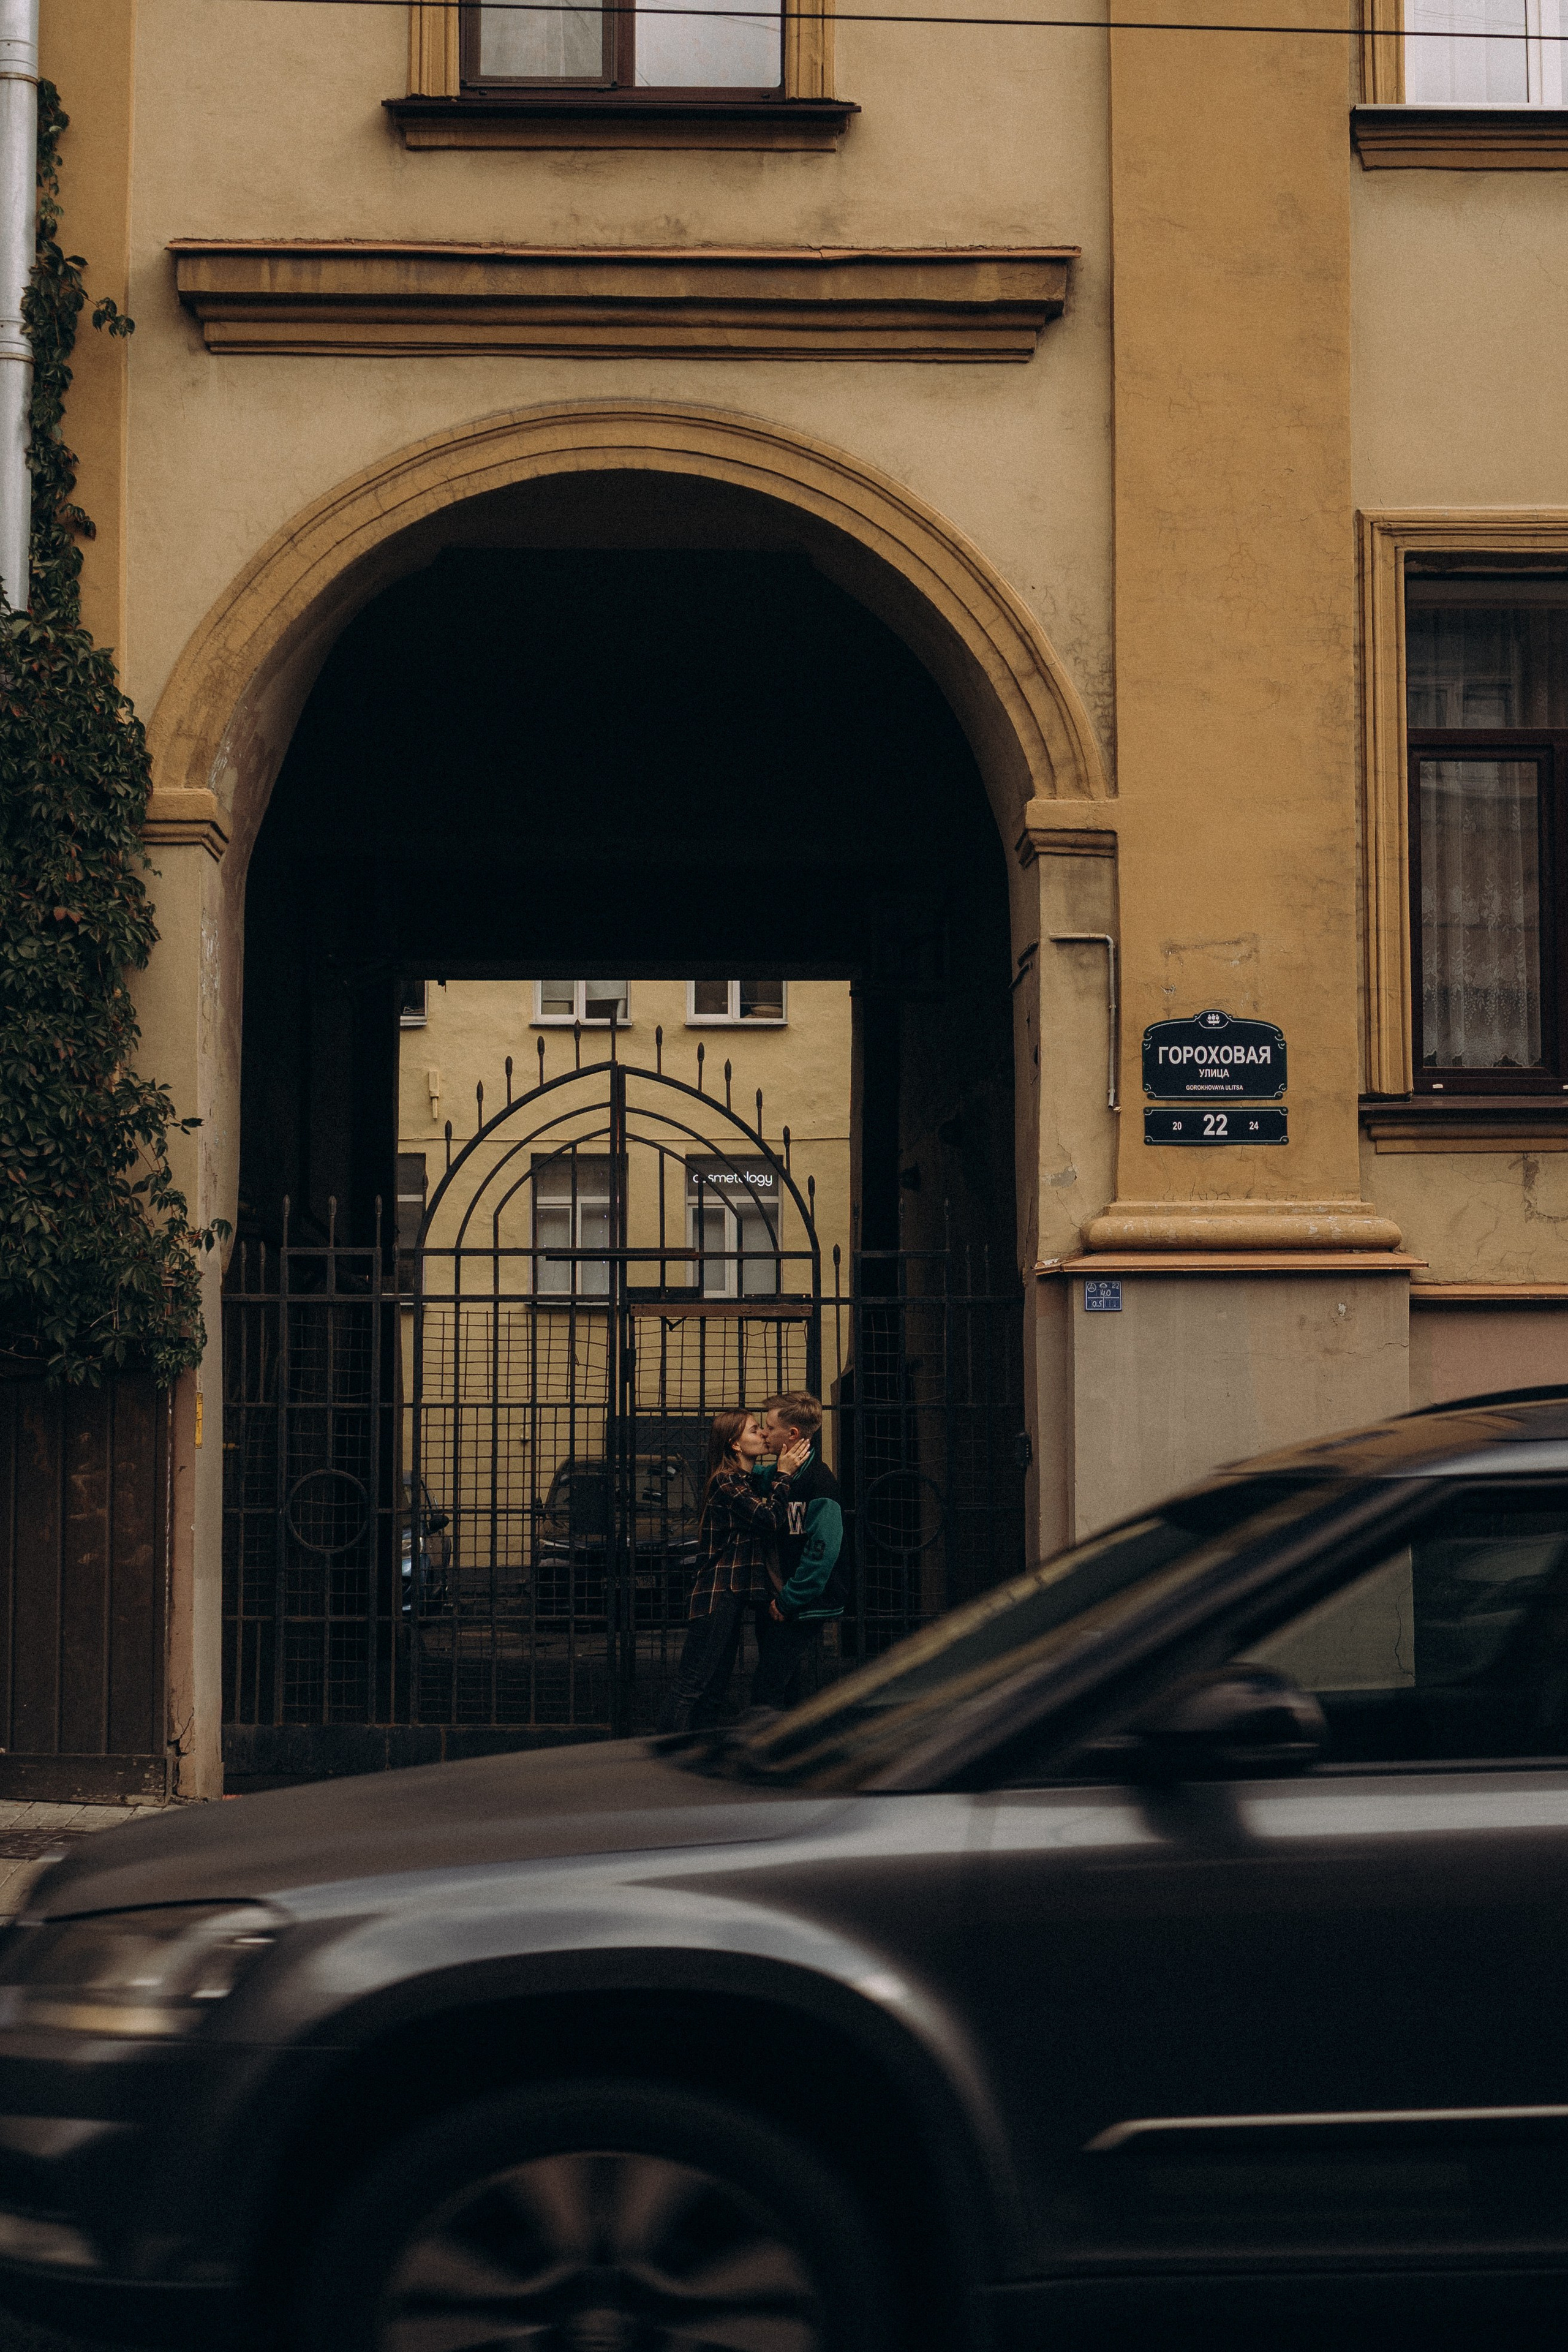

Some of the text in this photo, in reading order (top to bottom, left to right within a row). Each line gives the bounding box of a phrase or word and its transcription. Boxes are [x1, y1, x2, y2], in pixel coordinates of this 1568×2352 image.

[1159, 1046, 1271, 1064] ГОРОХОВАЯ
[1199, 1069, 1229, 1078] УЛИЦА
[1173, 1114, 1259, 1135] 20 22 24
[693, 1171, 773, 1186] csmetlogy
[787, 1501, 807, 1534] W
